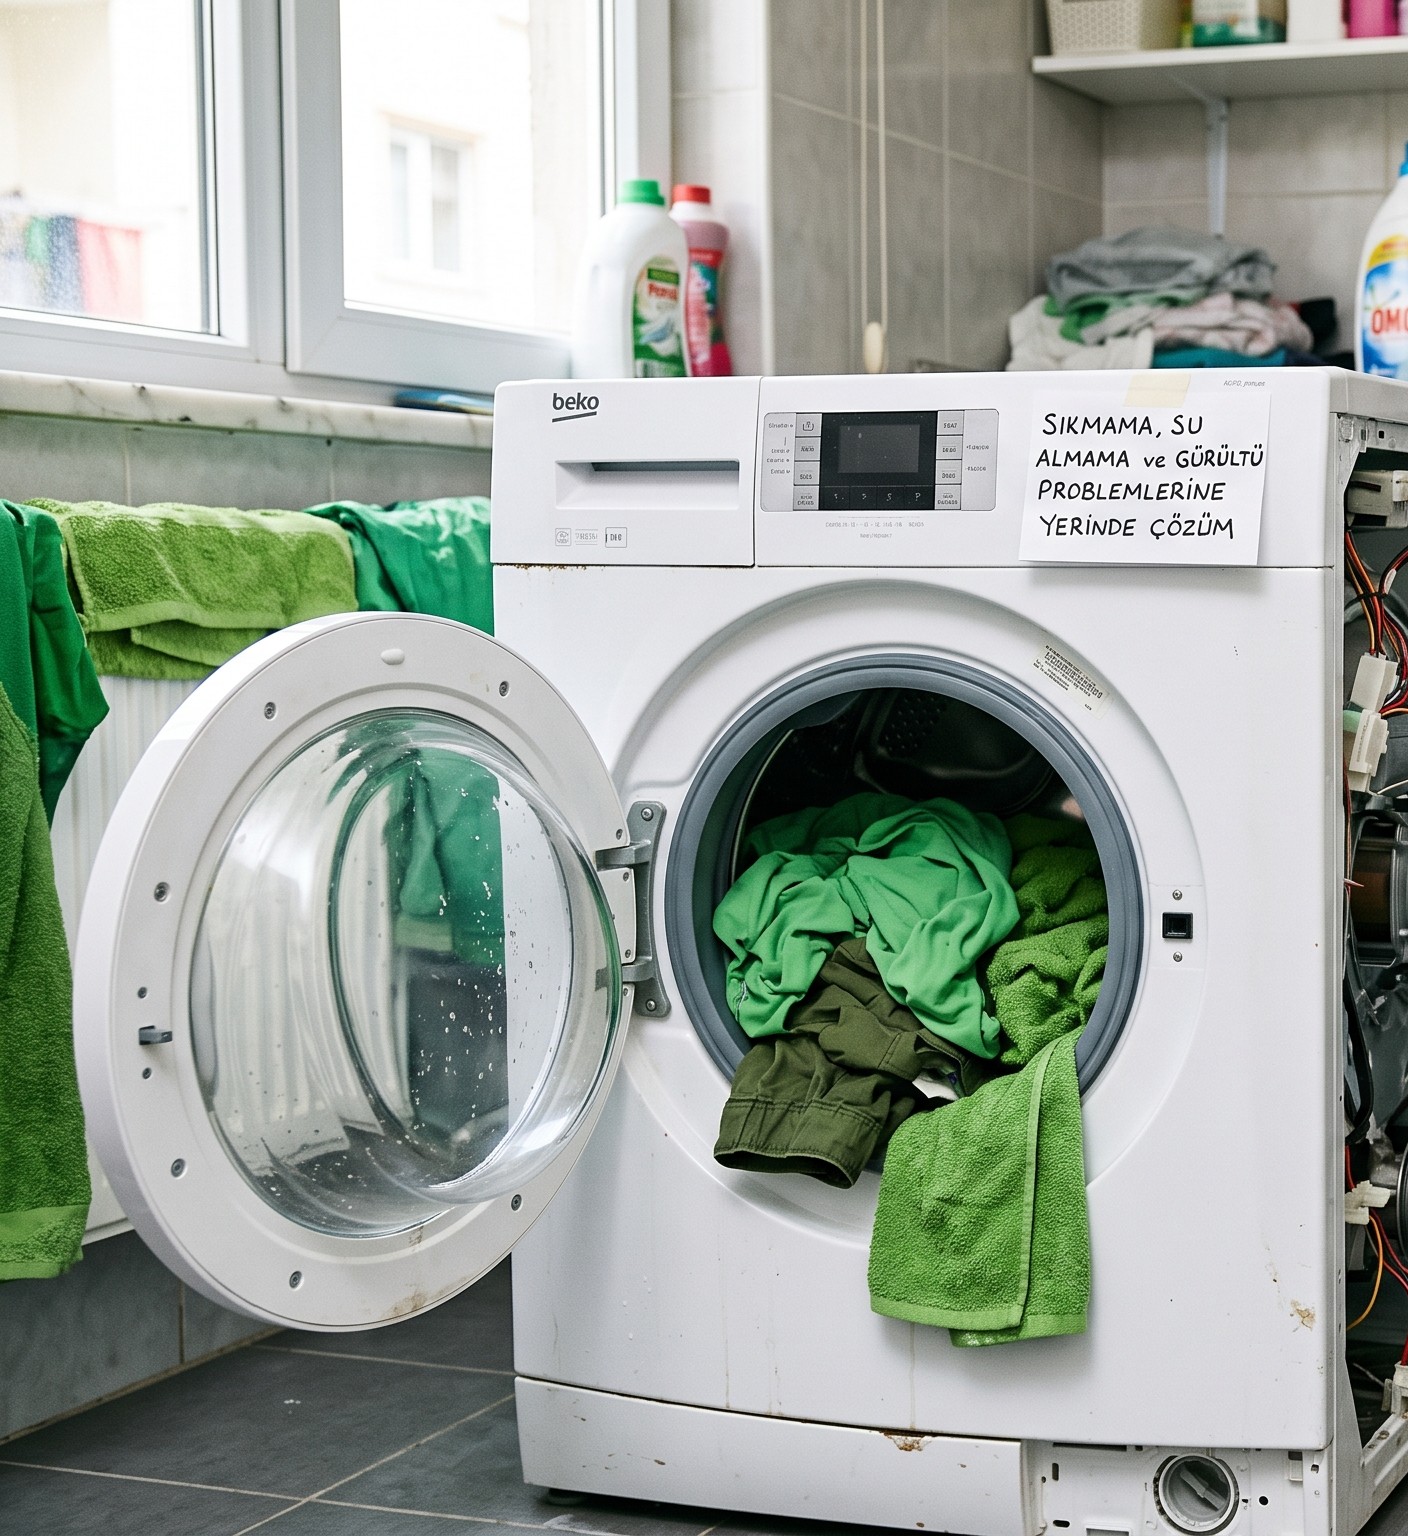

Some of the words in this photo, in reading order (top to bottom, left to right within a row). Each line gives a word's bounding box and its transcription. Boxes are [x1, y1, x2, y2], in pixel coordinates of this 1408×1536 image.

[552, 392, 600, 411] beko
[1042, 412, 1162, 439] SIKMAMA,
[1170, 414, 1203, 436] SU
[1035, 448, 1130, 468] ALMAMA
[1143, 455, 1166, 469] ve
[1175, 443, 1264, 469] GÜRÜLTÜ
[1038, 477, 1226, 501] PROBLEMLERİNE
[1040, 513, 1137, 537] YERİNDE
[1149, 511, 1234, 541] ÇÖZÜM
